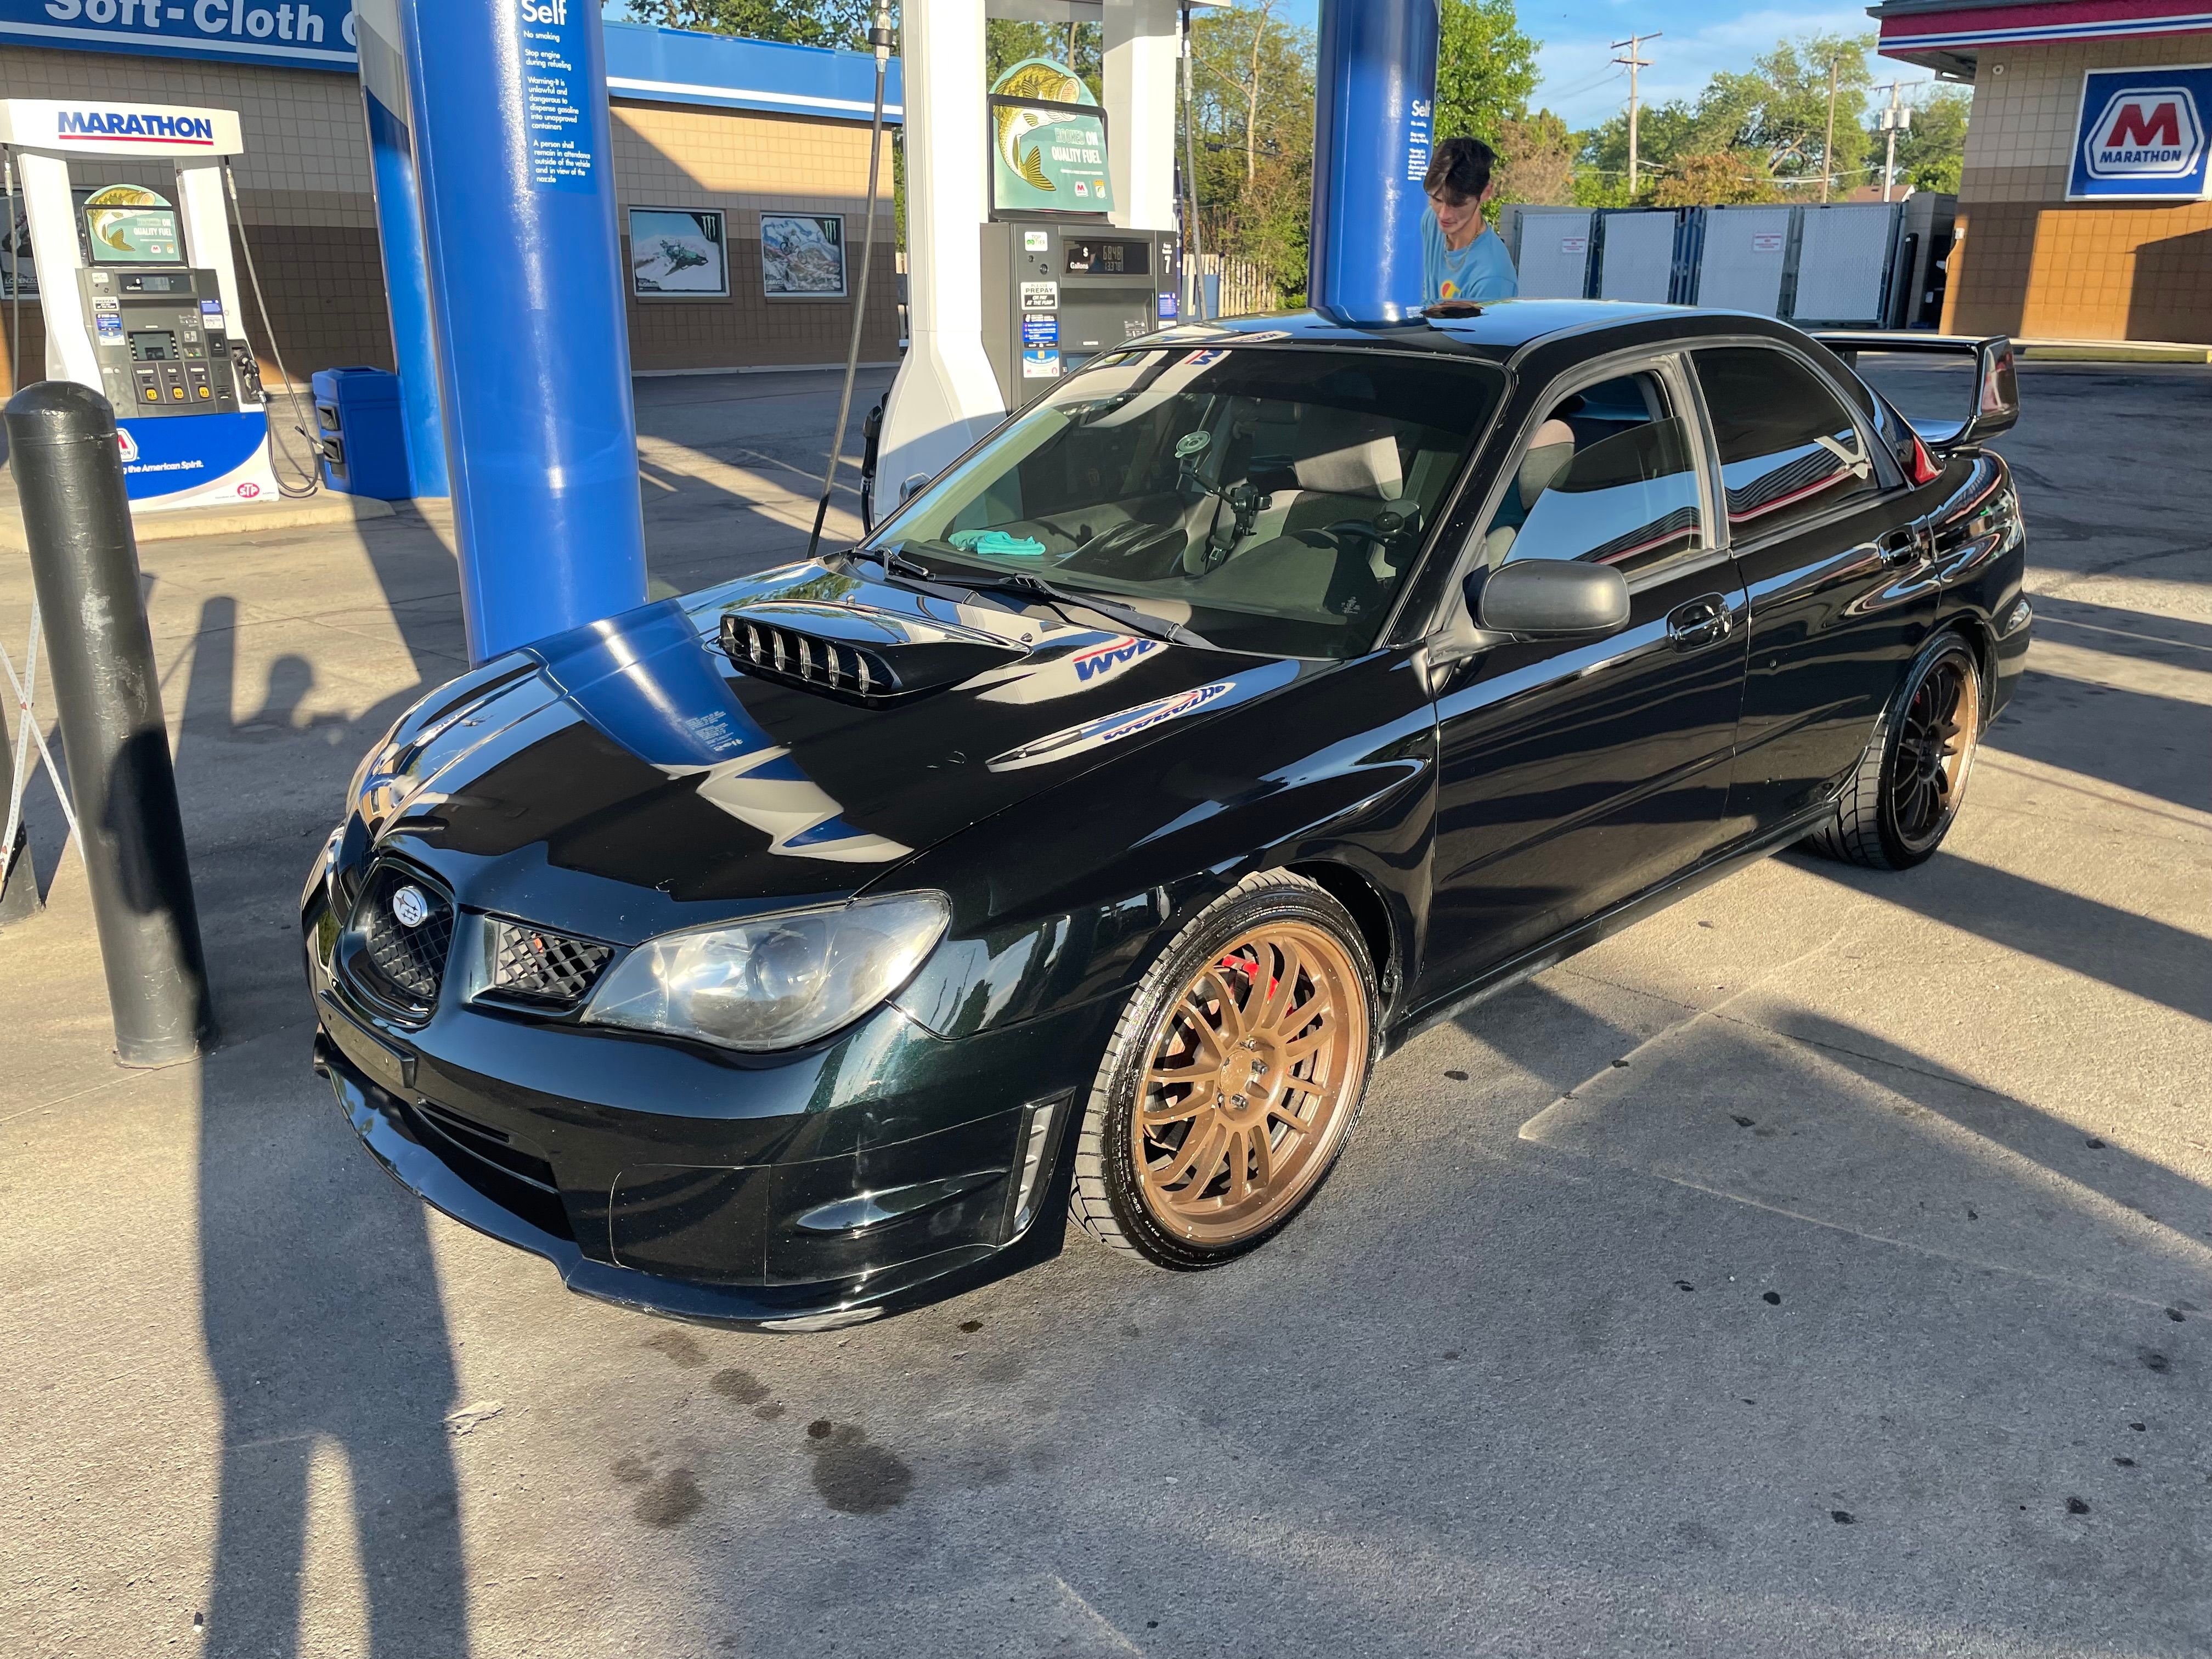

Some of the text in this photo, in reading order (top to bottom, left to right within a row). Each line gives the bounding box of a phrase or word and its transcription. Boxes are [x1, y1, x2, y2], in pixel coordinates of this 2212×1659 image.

[522, 0, 567, 25] Self
[523, 30, 560, 43] No smoking
[525, 48, 560, 60] Stop engine
[526, 57, 572, 71] during refueling
[528, 85, 555, 94] unlawful
[529, 94, 561, 104] dangerous
[529, 103, 579, 115] dispense gasoline
[58, 111, 213, 139] MARATHON
[544, 115, 578, 123] unapproved
[2106, 103, 2180, 146] M
[532, 122, 562, 130] containers
[562, 140, 574, 149] shall
[1086, 131, 1099, 146] ON
[563, 150, 591, 159] attendance
[1051, 146, 1102, 164] QUALITY FUEL
[2100, 150, 2182, 163] MARATHON
[534, 157, 591, 168] outside of the vehicle
[571, 167, 577, 176] of
[536, 174, 556, 183] nozzle
[133, 227, 173, 236] QUALITY FUEL
[1164, 256, 1171, 274] 7
[128, 465, 141, 473] the
[142, 462, 180, 472] American
[239, 483, 259, 497] STP
